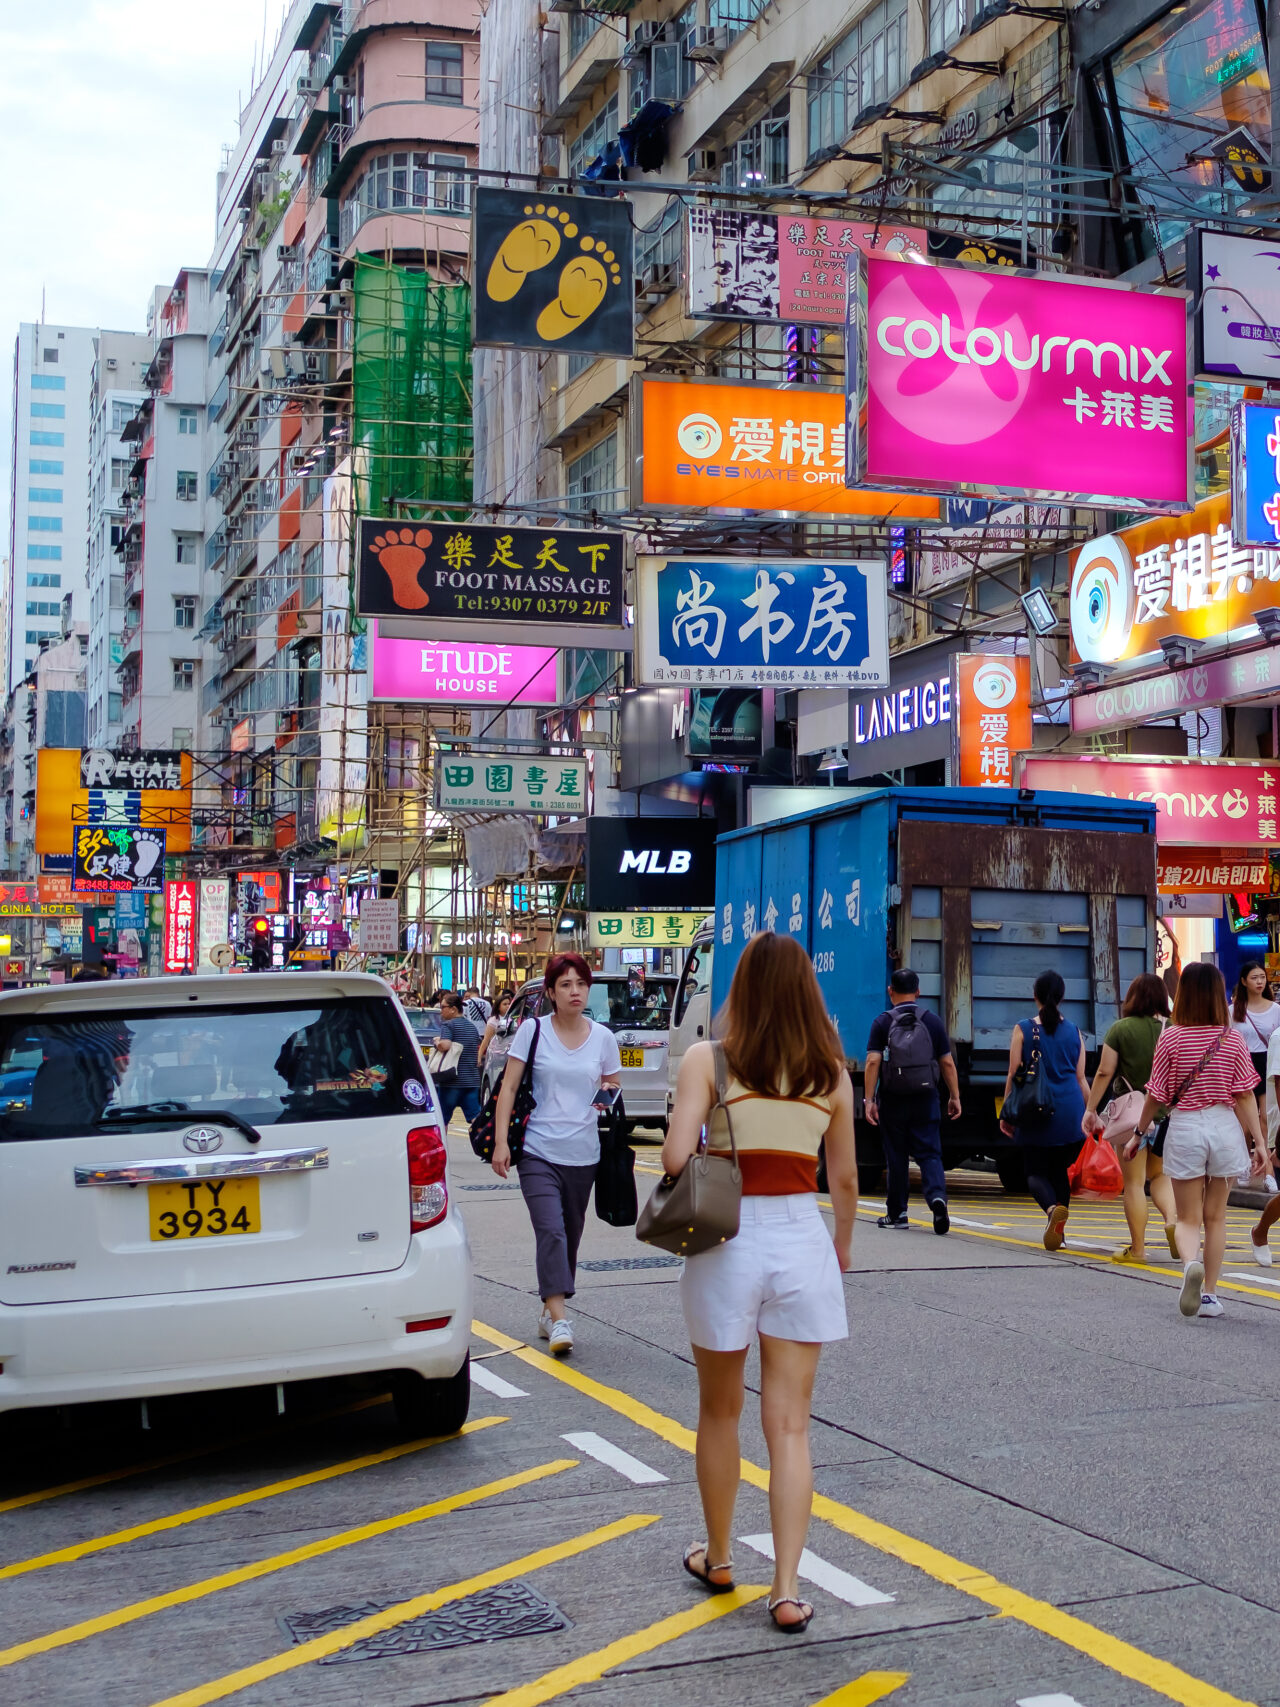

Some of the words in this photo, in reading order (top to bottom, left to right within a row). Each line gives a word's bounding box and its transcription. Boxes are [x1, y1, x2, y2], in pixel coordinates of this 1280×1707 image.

[787, 222, 882, 250] 樂足天下
[797, 248, 824, 257] FOOT
[824, 306, 842, 315] open
[1062, 386, 1174, 433] 卡萊美
[744, 467, 799, 482] MATE
[440, 531, 611, 574] 樂足天下
[435, 571, 498, 591] FOOT
[502, 574, 611, 596] MASSAGE
[454, 594, 532, 613] Tel:9307
[537, 598, 578, 615] 0379
[582, 600, 611, 616] 2/F
[671, 567, 857, 664] 尚书房
[421, 649, 513, 676] ETUDE
[435, 678, 498, 694] HOUSE
[855, 676, 951, 744] LANEIGE
[133, 779, 178, 789] HAIR
[444, 764, 581, 797] 田園書屋
[1257, 770, 1277, 840] 卡萊美
[619, 850, 692, 874] MLB
[137, 877, 157, 887] 2/F
[41, 904, 79, 913] HOTEL
[182, 1181, 226, 1210] TY
[158, 1205, 251, 1239] 3934
